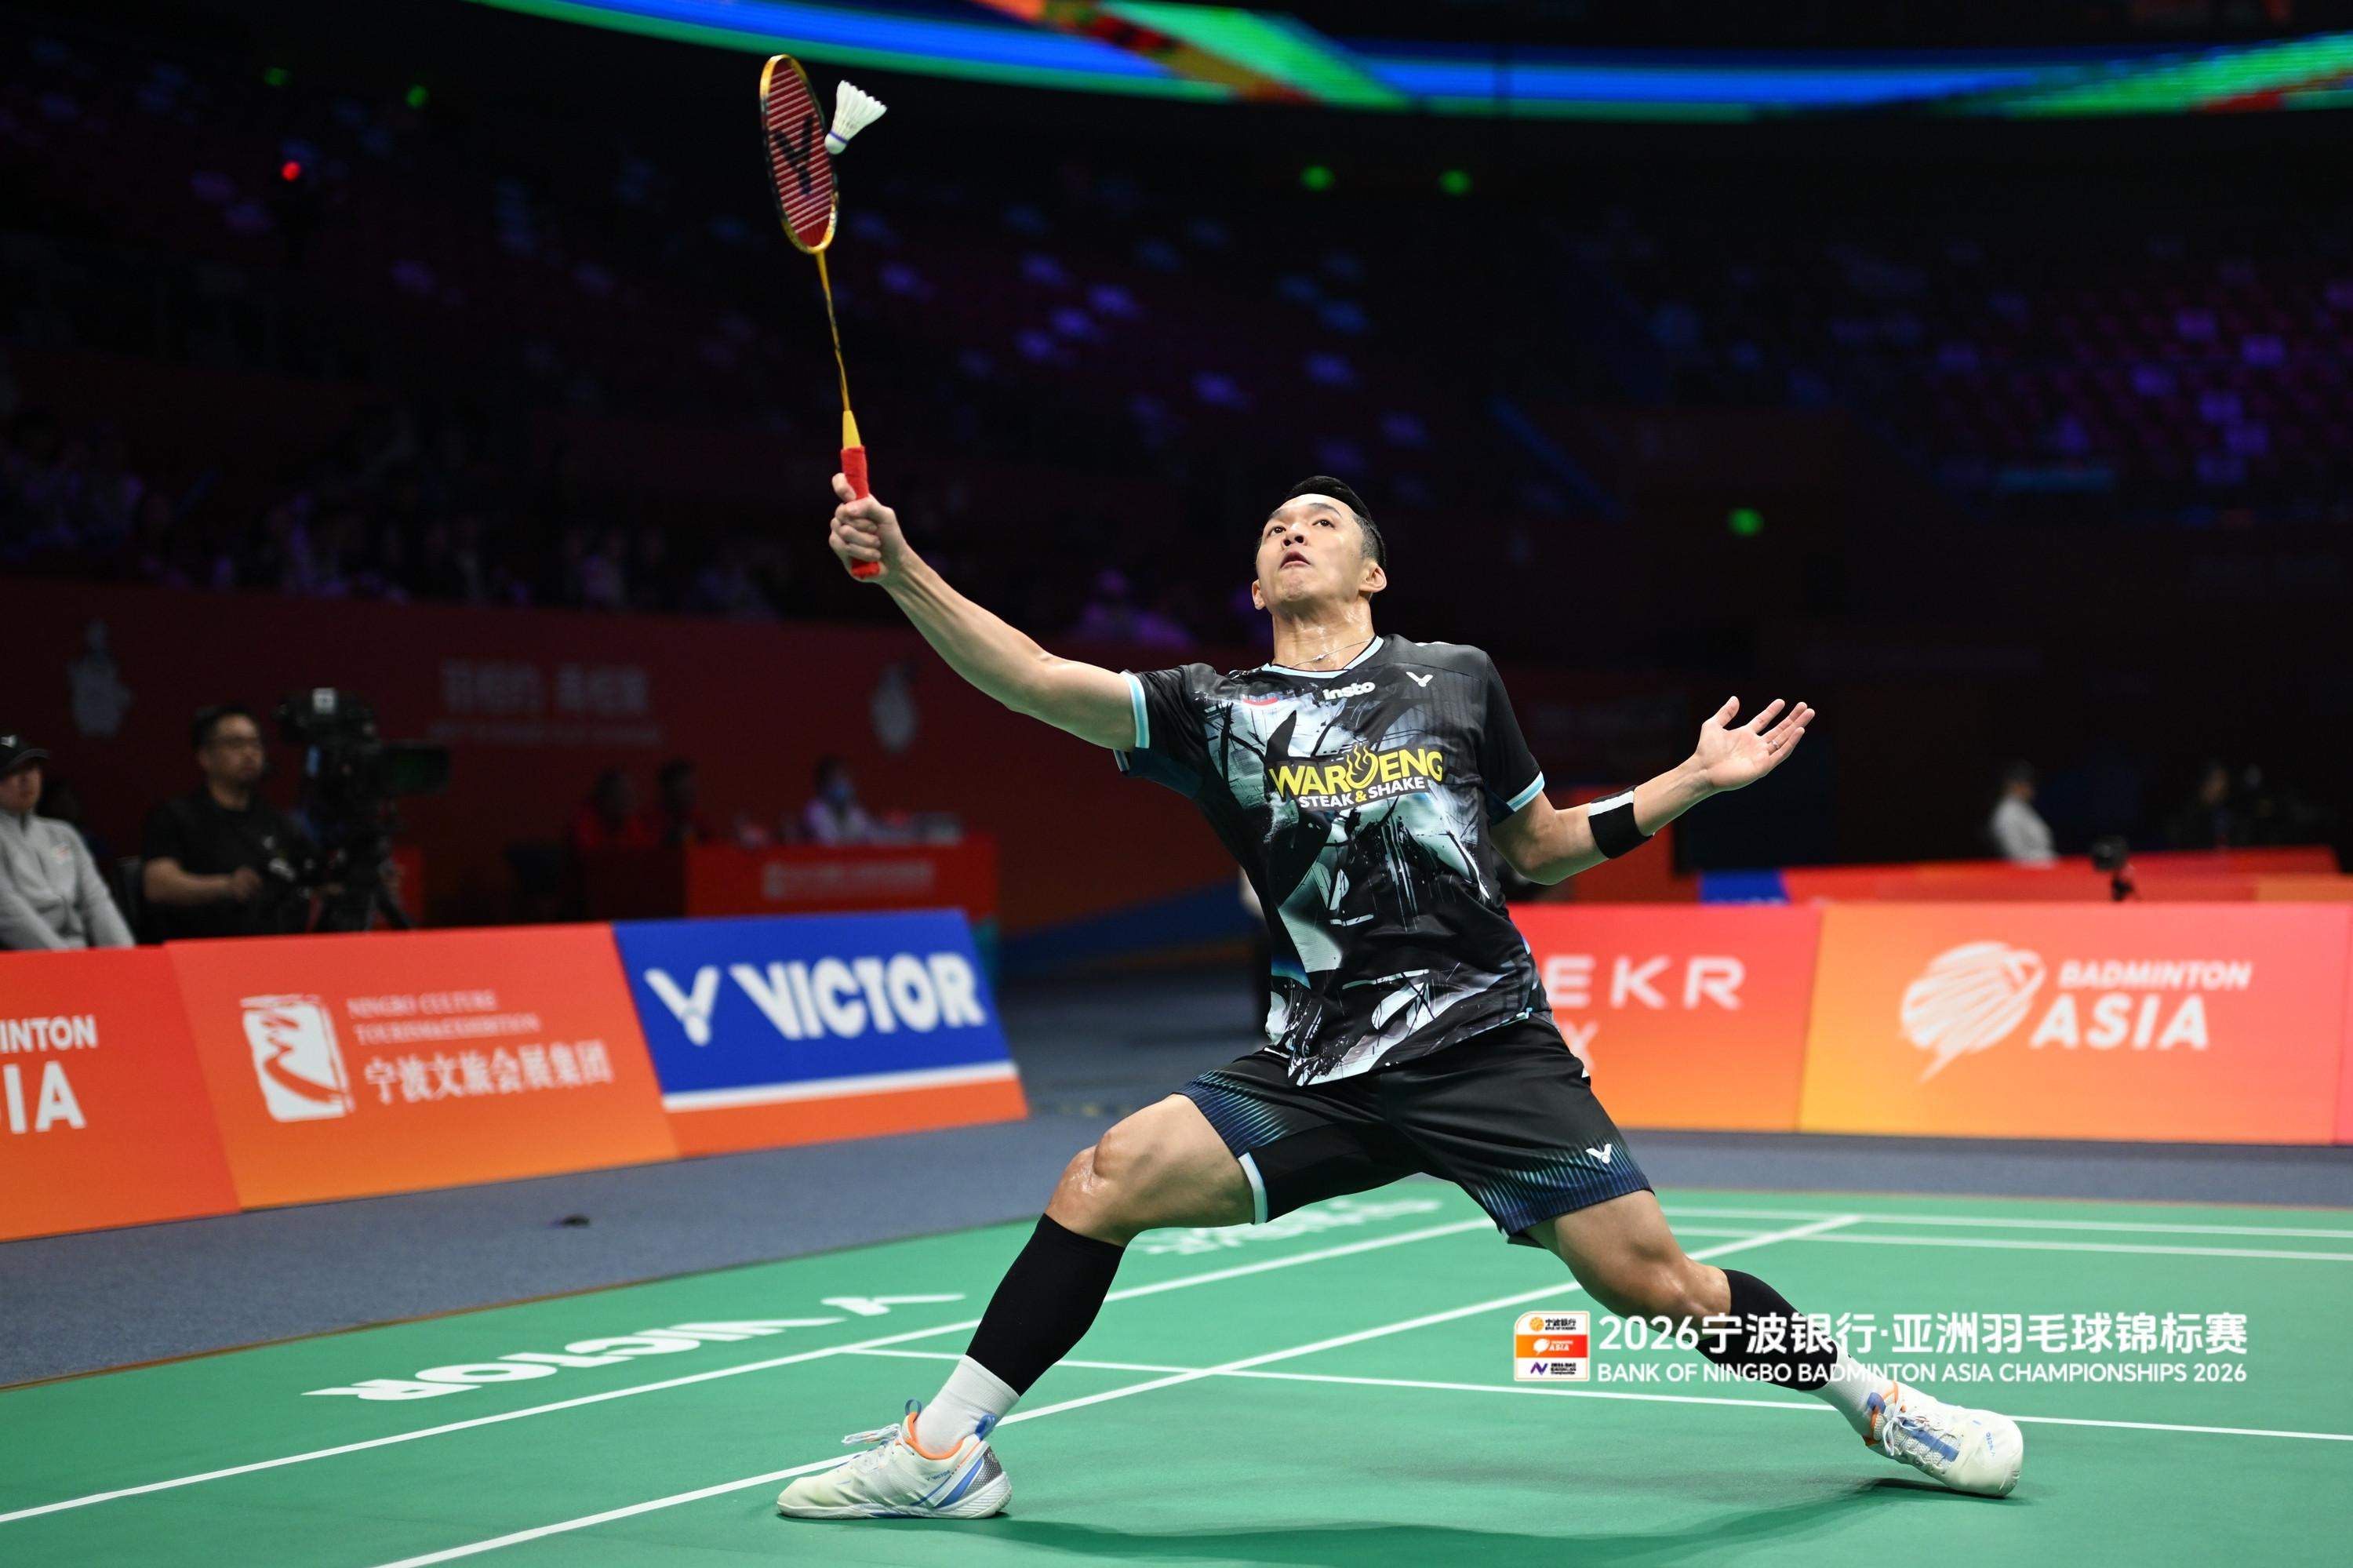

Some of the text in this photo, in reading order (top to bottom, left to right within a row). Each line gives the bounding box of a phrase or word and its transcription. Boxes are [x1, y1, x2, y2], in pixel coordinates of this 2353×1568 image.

[1322, 682, 1376, 700] insto
[1300, 777, 1425, 808] STEAK & SHAKE
[728, 952, 986, 1040] VICTOR
[2058, 959, 2253, 991] BADMINTON
[2028, 992, 2209, 1051] ASIA
[364, 1039, 613, 1105] 宁波文旅会展集团
